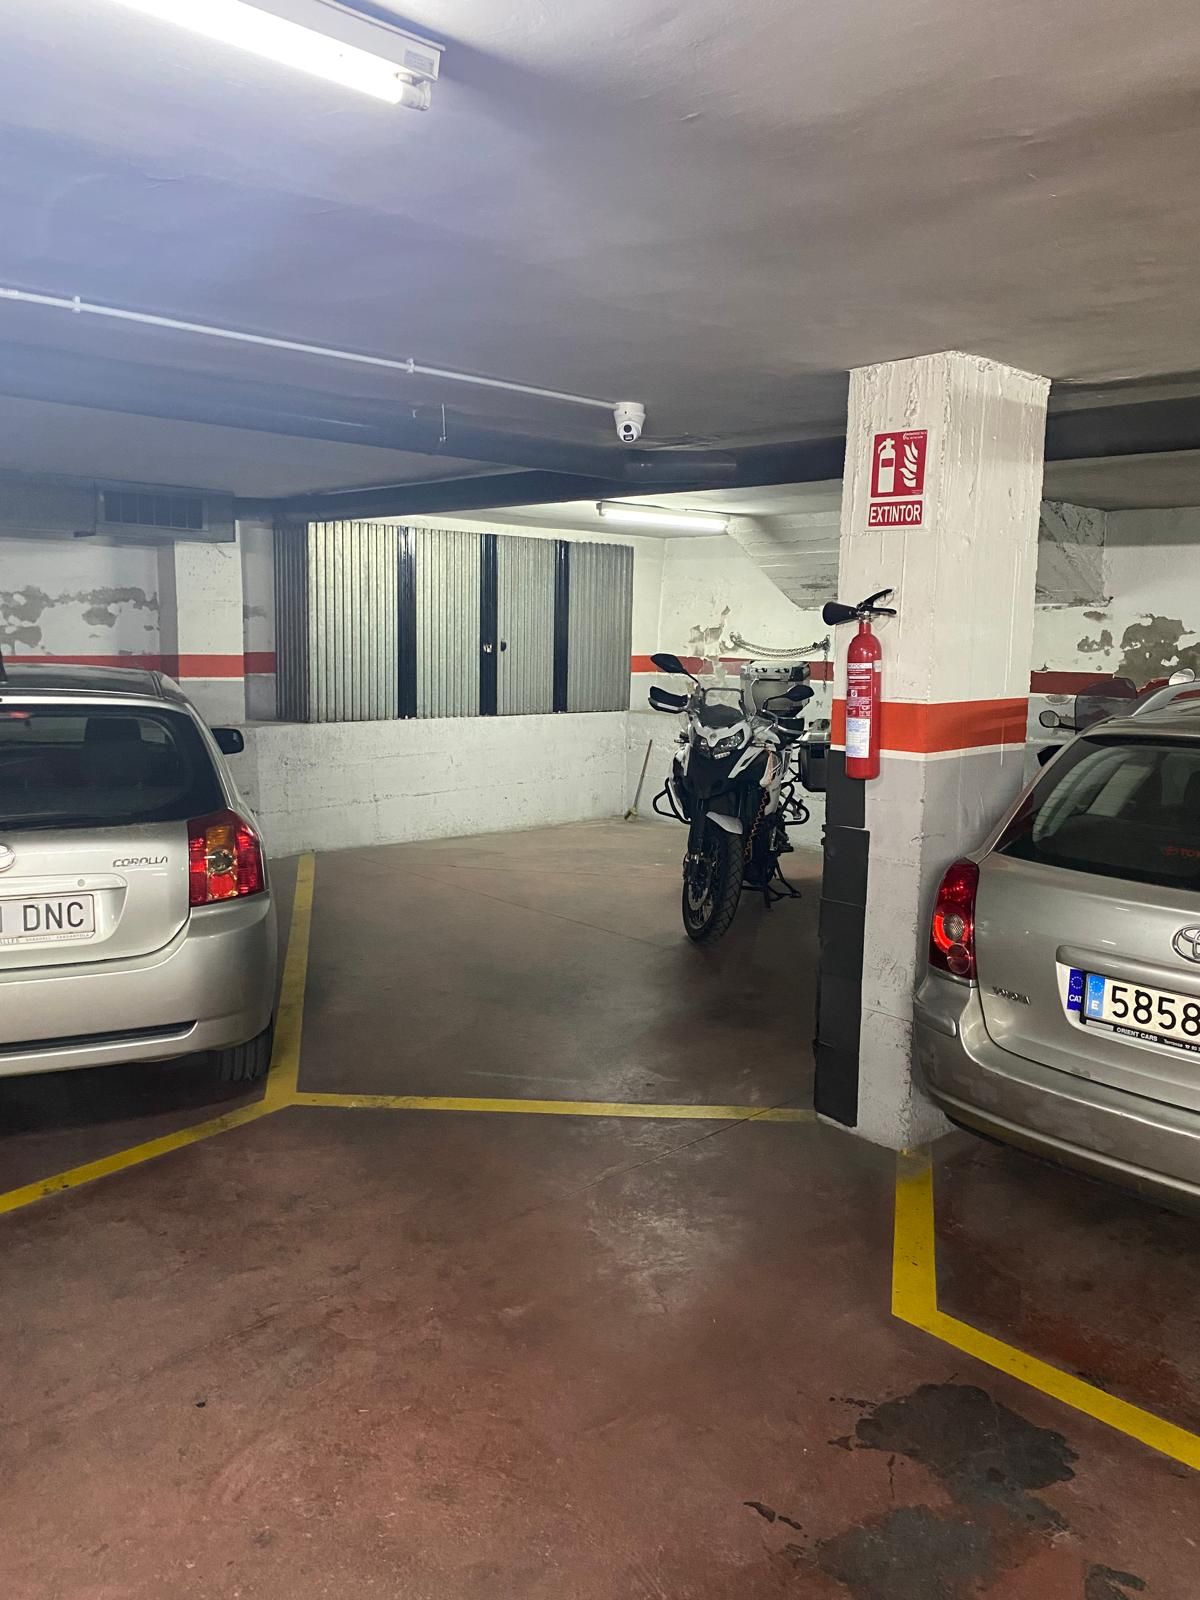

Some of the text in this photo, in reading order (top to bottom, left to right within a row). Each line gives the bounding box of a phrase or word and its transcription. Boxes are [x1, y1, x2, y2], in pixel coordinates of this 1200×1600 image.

[870, 504, 921, 523] EXTINTOR
[112, 855, 168, 867] COROLLA
[23, 901, 84, 931] DNC
[1091, 985, 1200, 1036] E 5858
[1116, 1026, 1139, 1038] ORIENT
[1140, 1032, 1158, 1042] CARS
